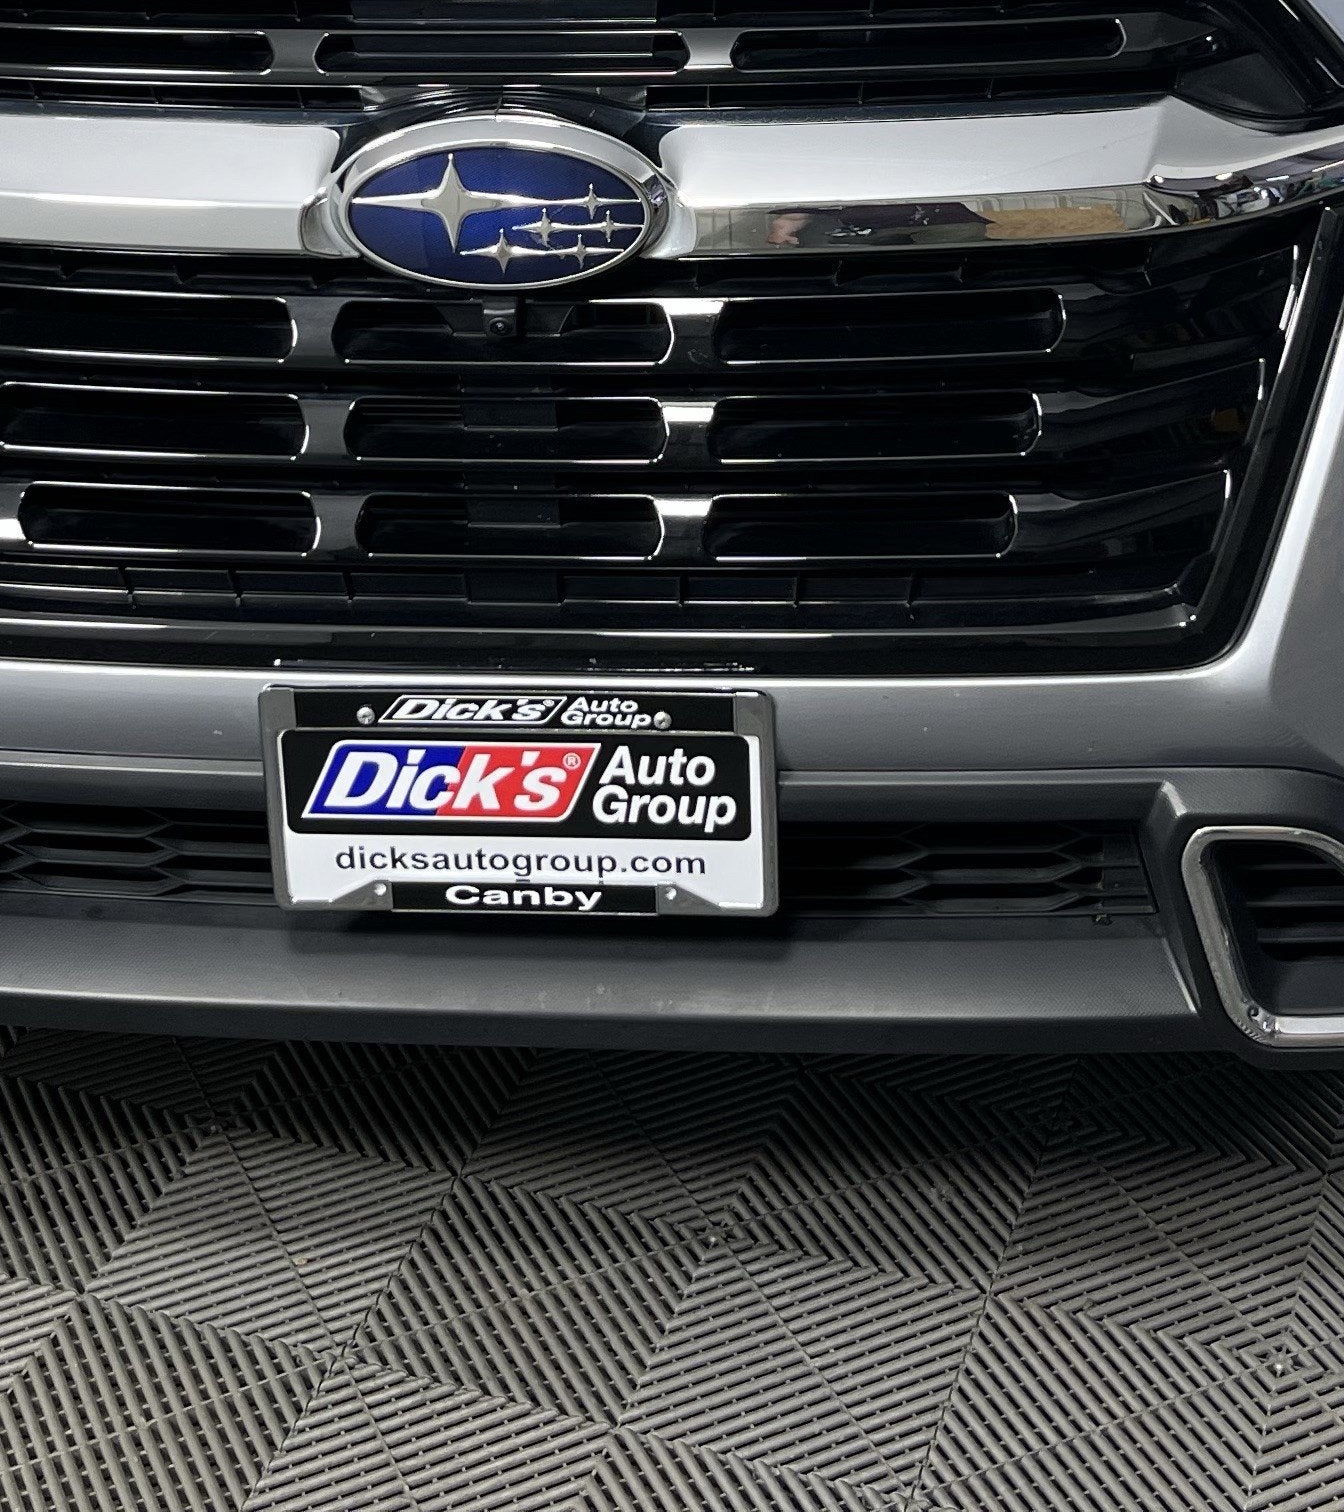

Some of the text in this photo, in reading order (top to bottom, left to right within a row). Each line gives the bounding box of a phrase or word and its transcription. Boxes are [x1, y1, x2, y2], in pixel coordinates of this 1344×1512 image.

[392, 696, 639, 721] Dick's Auto
[560, 711, 653, 729] Group
[323, 745, 717, 812] Dick's Auto
[592, 785, 738, 833] Group
[335, 845, 707, 876] dicksautogroup.com
[444, 884, 603, 912] Canby
